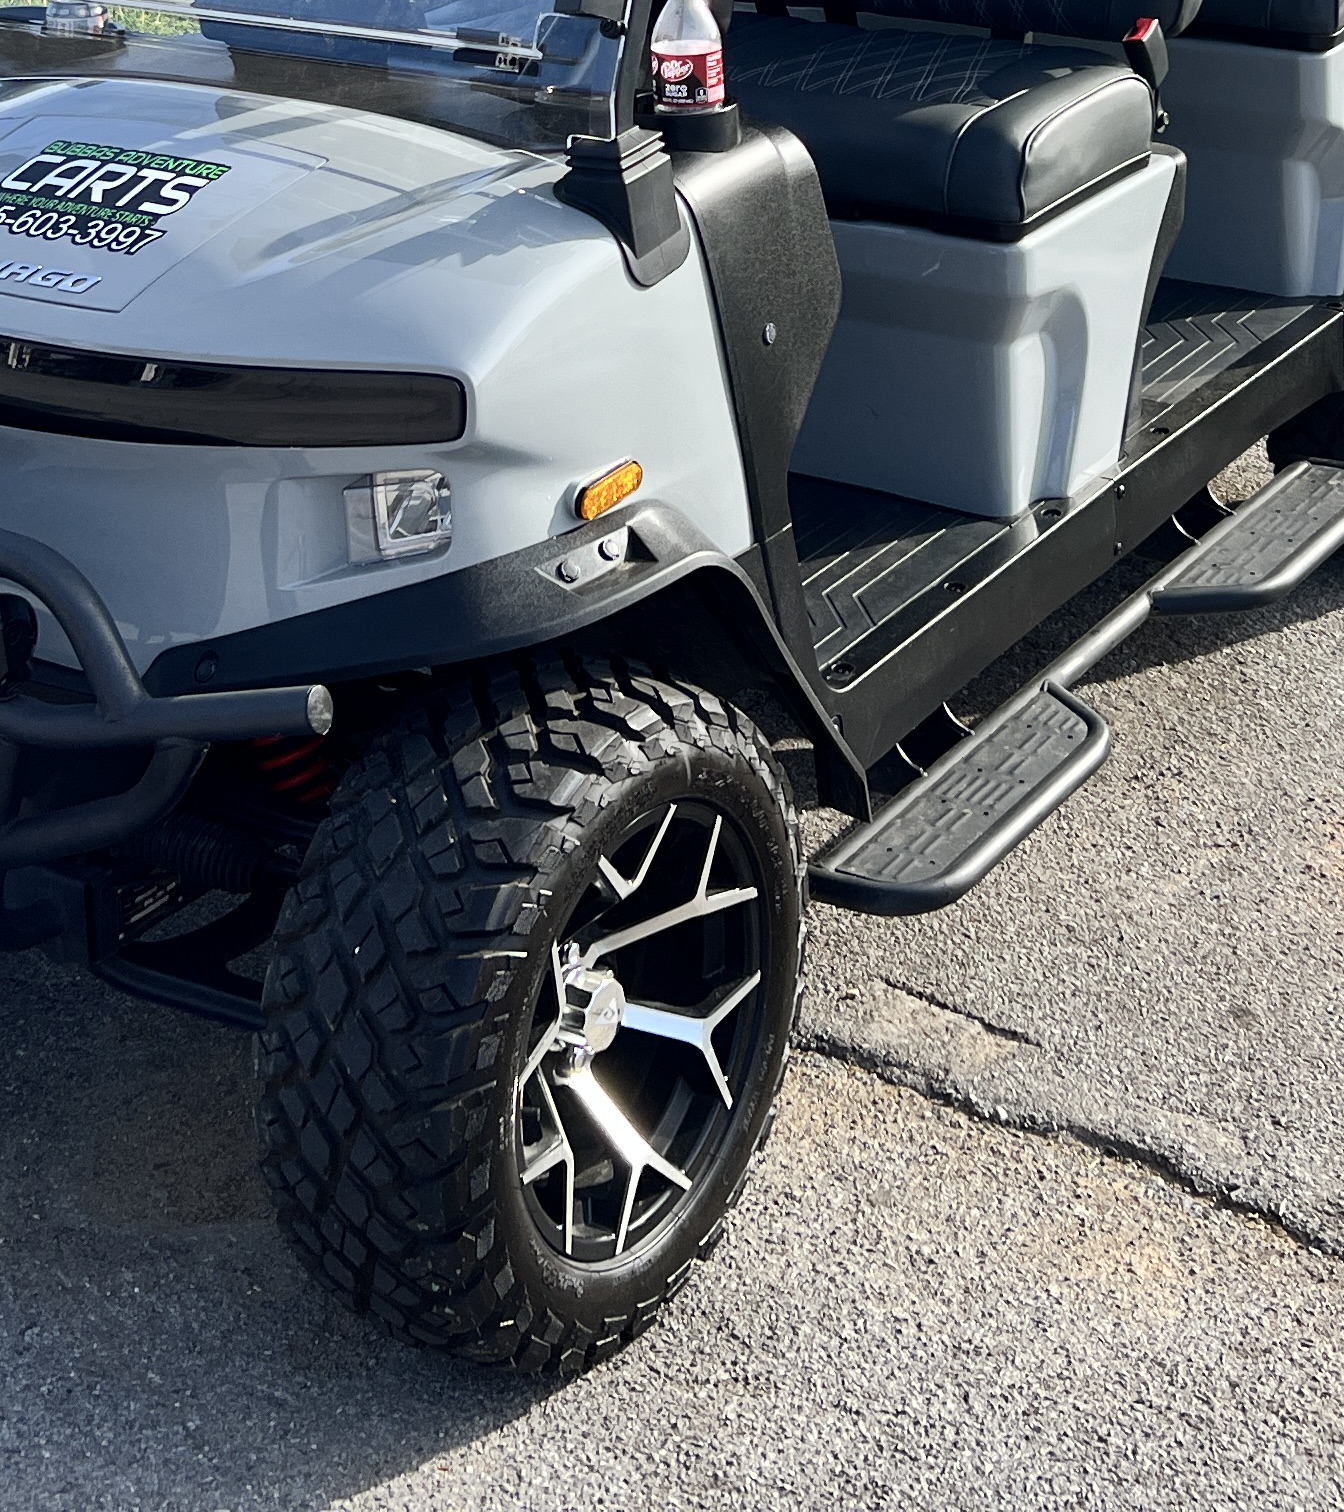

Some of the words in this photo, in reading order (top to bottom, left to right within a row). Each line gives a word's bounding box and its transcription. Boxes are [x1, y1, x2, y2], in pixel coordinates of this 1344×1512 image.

[45, 140, 114, 160] BUBBAS
[117, 150, 232, 180] ADVENTURE
[0, 154, 212, 216] CARTS
[31, 196, 59, 211] YOUR
[55, 201, 114, 220] ADVENTURE
[111, 210, 152, 227] STARTS
